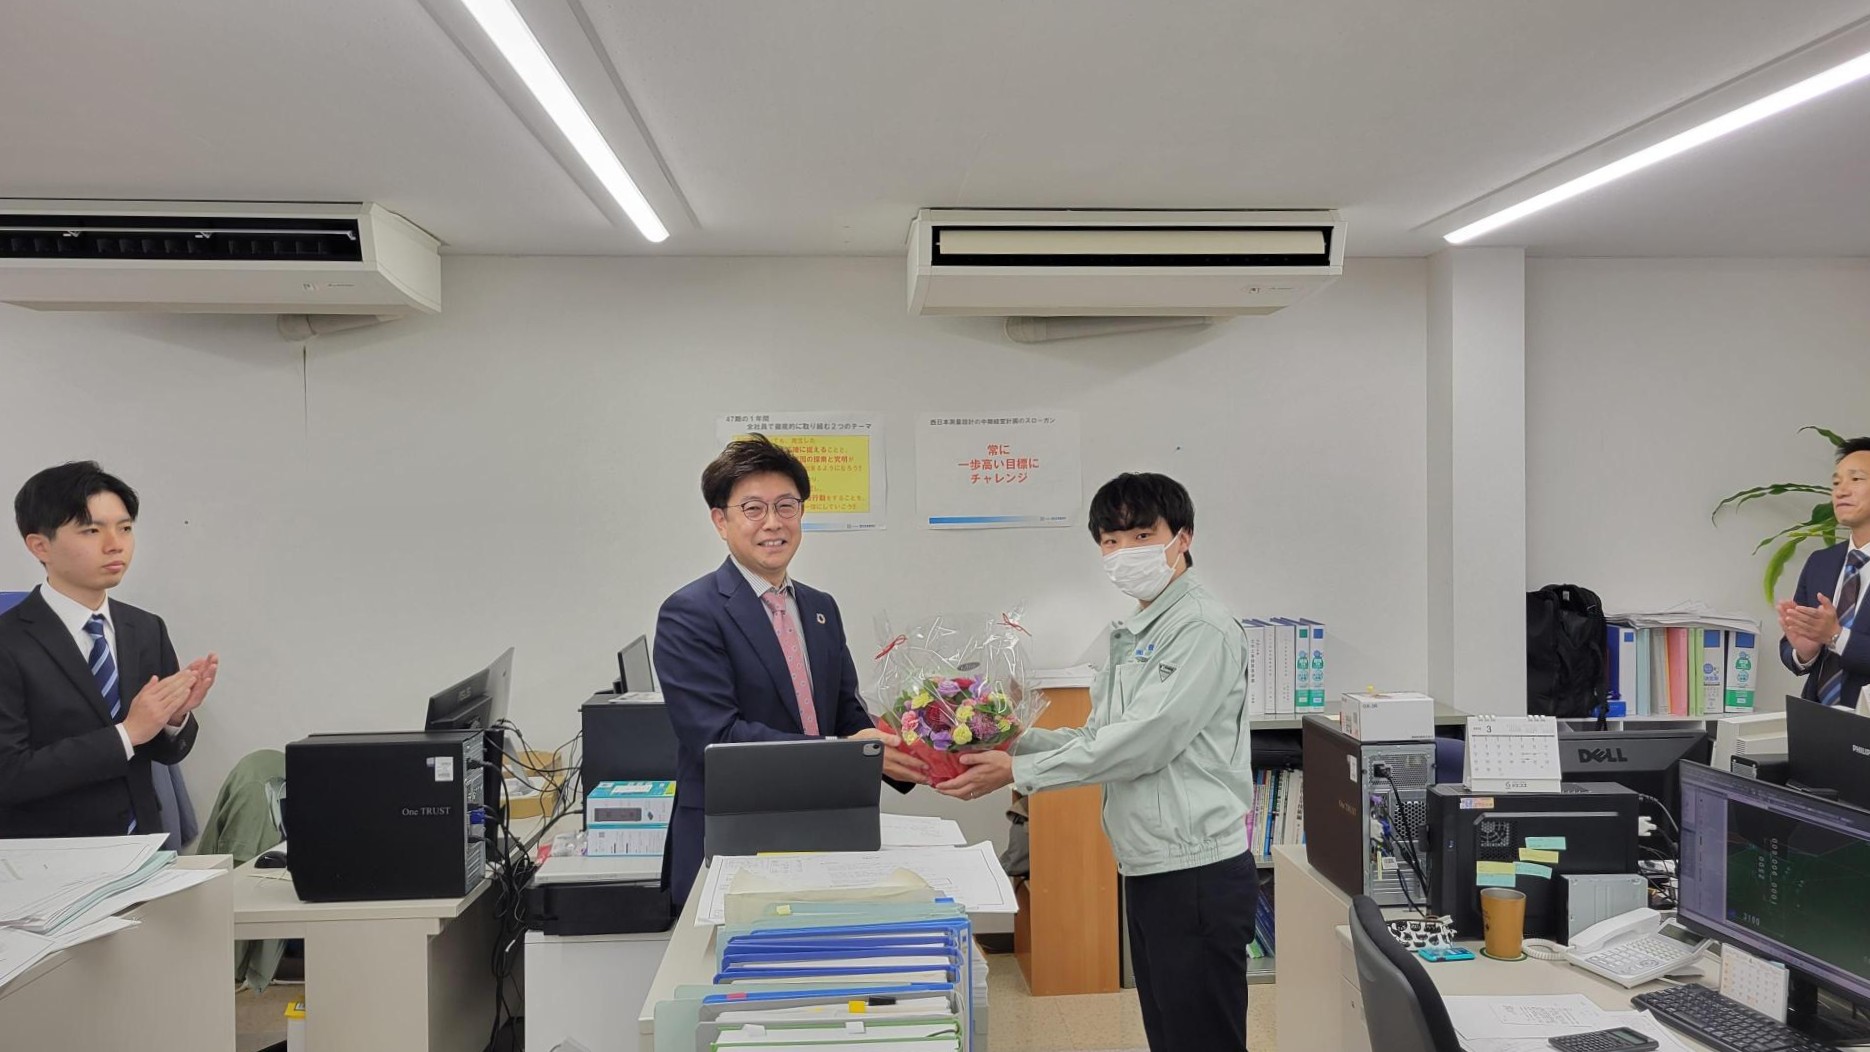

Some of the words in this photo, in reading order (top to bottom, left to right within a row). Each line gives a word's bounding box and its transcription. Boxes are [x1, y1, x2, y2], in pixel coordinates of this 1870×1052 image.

[987, 445, 1010, 455] 常に
[958, 458, 1039, 470] 一歩高い目標に
[970, 473, 1028, 484] チャレンジ
[1486, 725, 1492, 733] 3
[1578, 748, 1628, 763] DELL
[402, 808, 419, 816] One
[420, 807, 451, 815] TRUST
